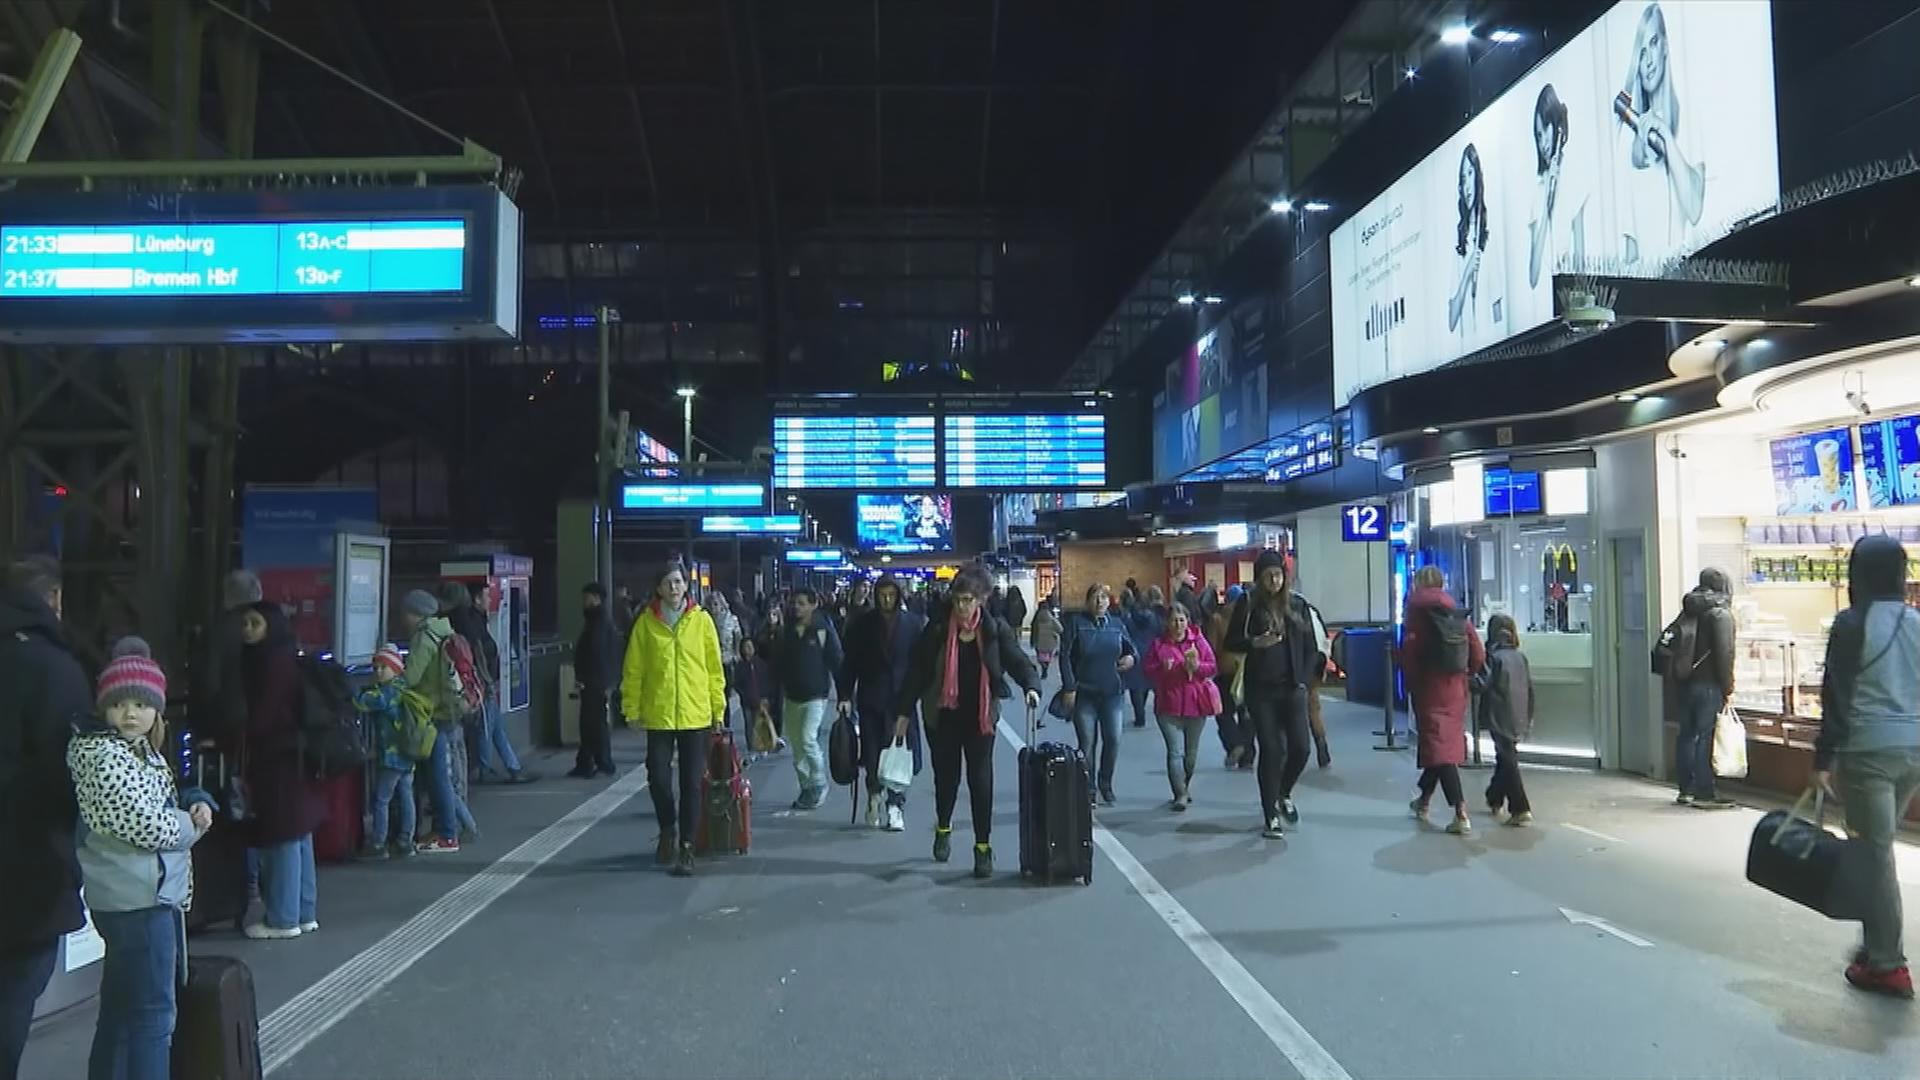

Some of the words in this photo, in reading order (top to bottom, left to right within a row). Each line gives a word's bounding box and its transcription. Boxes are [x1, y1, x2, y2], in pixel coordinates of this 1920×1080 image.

[4, 234, 57, 255] 21:33
[135, 233, 216, 257] Lüneburg
[4, 268, 56, 289] 21:37
[134, 268, 201, 287] Bremen
[206, 266, 239, 287] Hbf
[1346, 506, 1379, 535] 12
